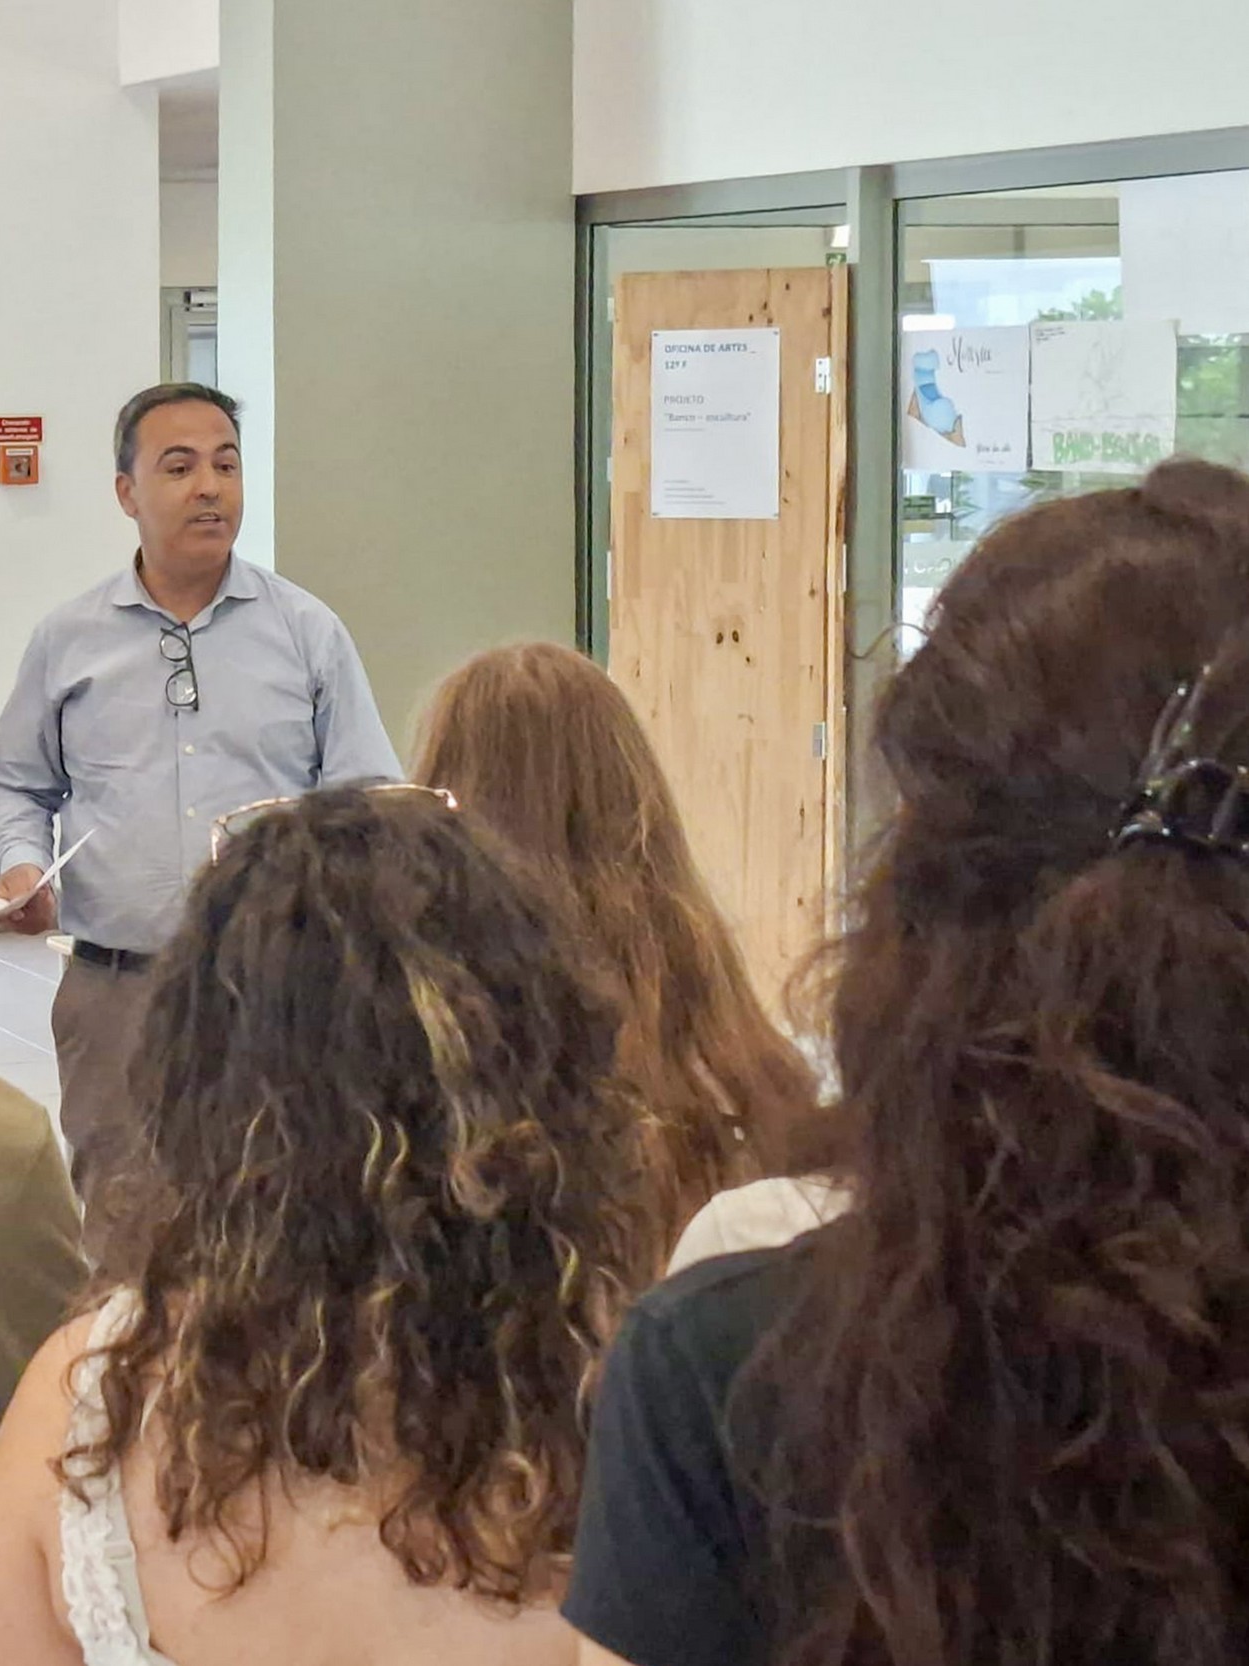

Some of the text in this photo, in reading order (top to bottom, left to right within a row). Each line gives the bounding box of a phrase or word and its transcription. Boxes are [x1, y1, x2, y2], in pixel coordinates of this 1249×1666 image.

[664, 344, 701, 353] OFICINA
[703, 344, 715, 353] DE
[718, 343, 748, 352] ARTES
